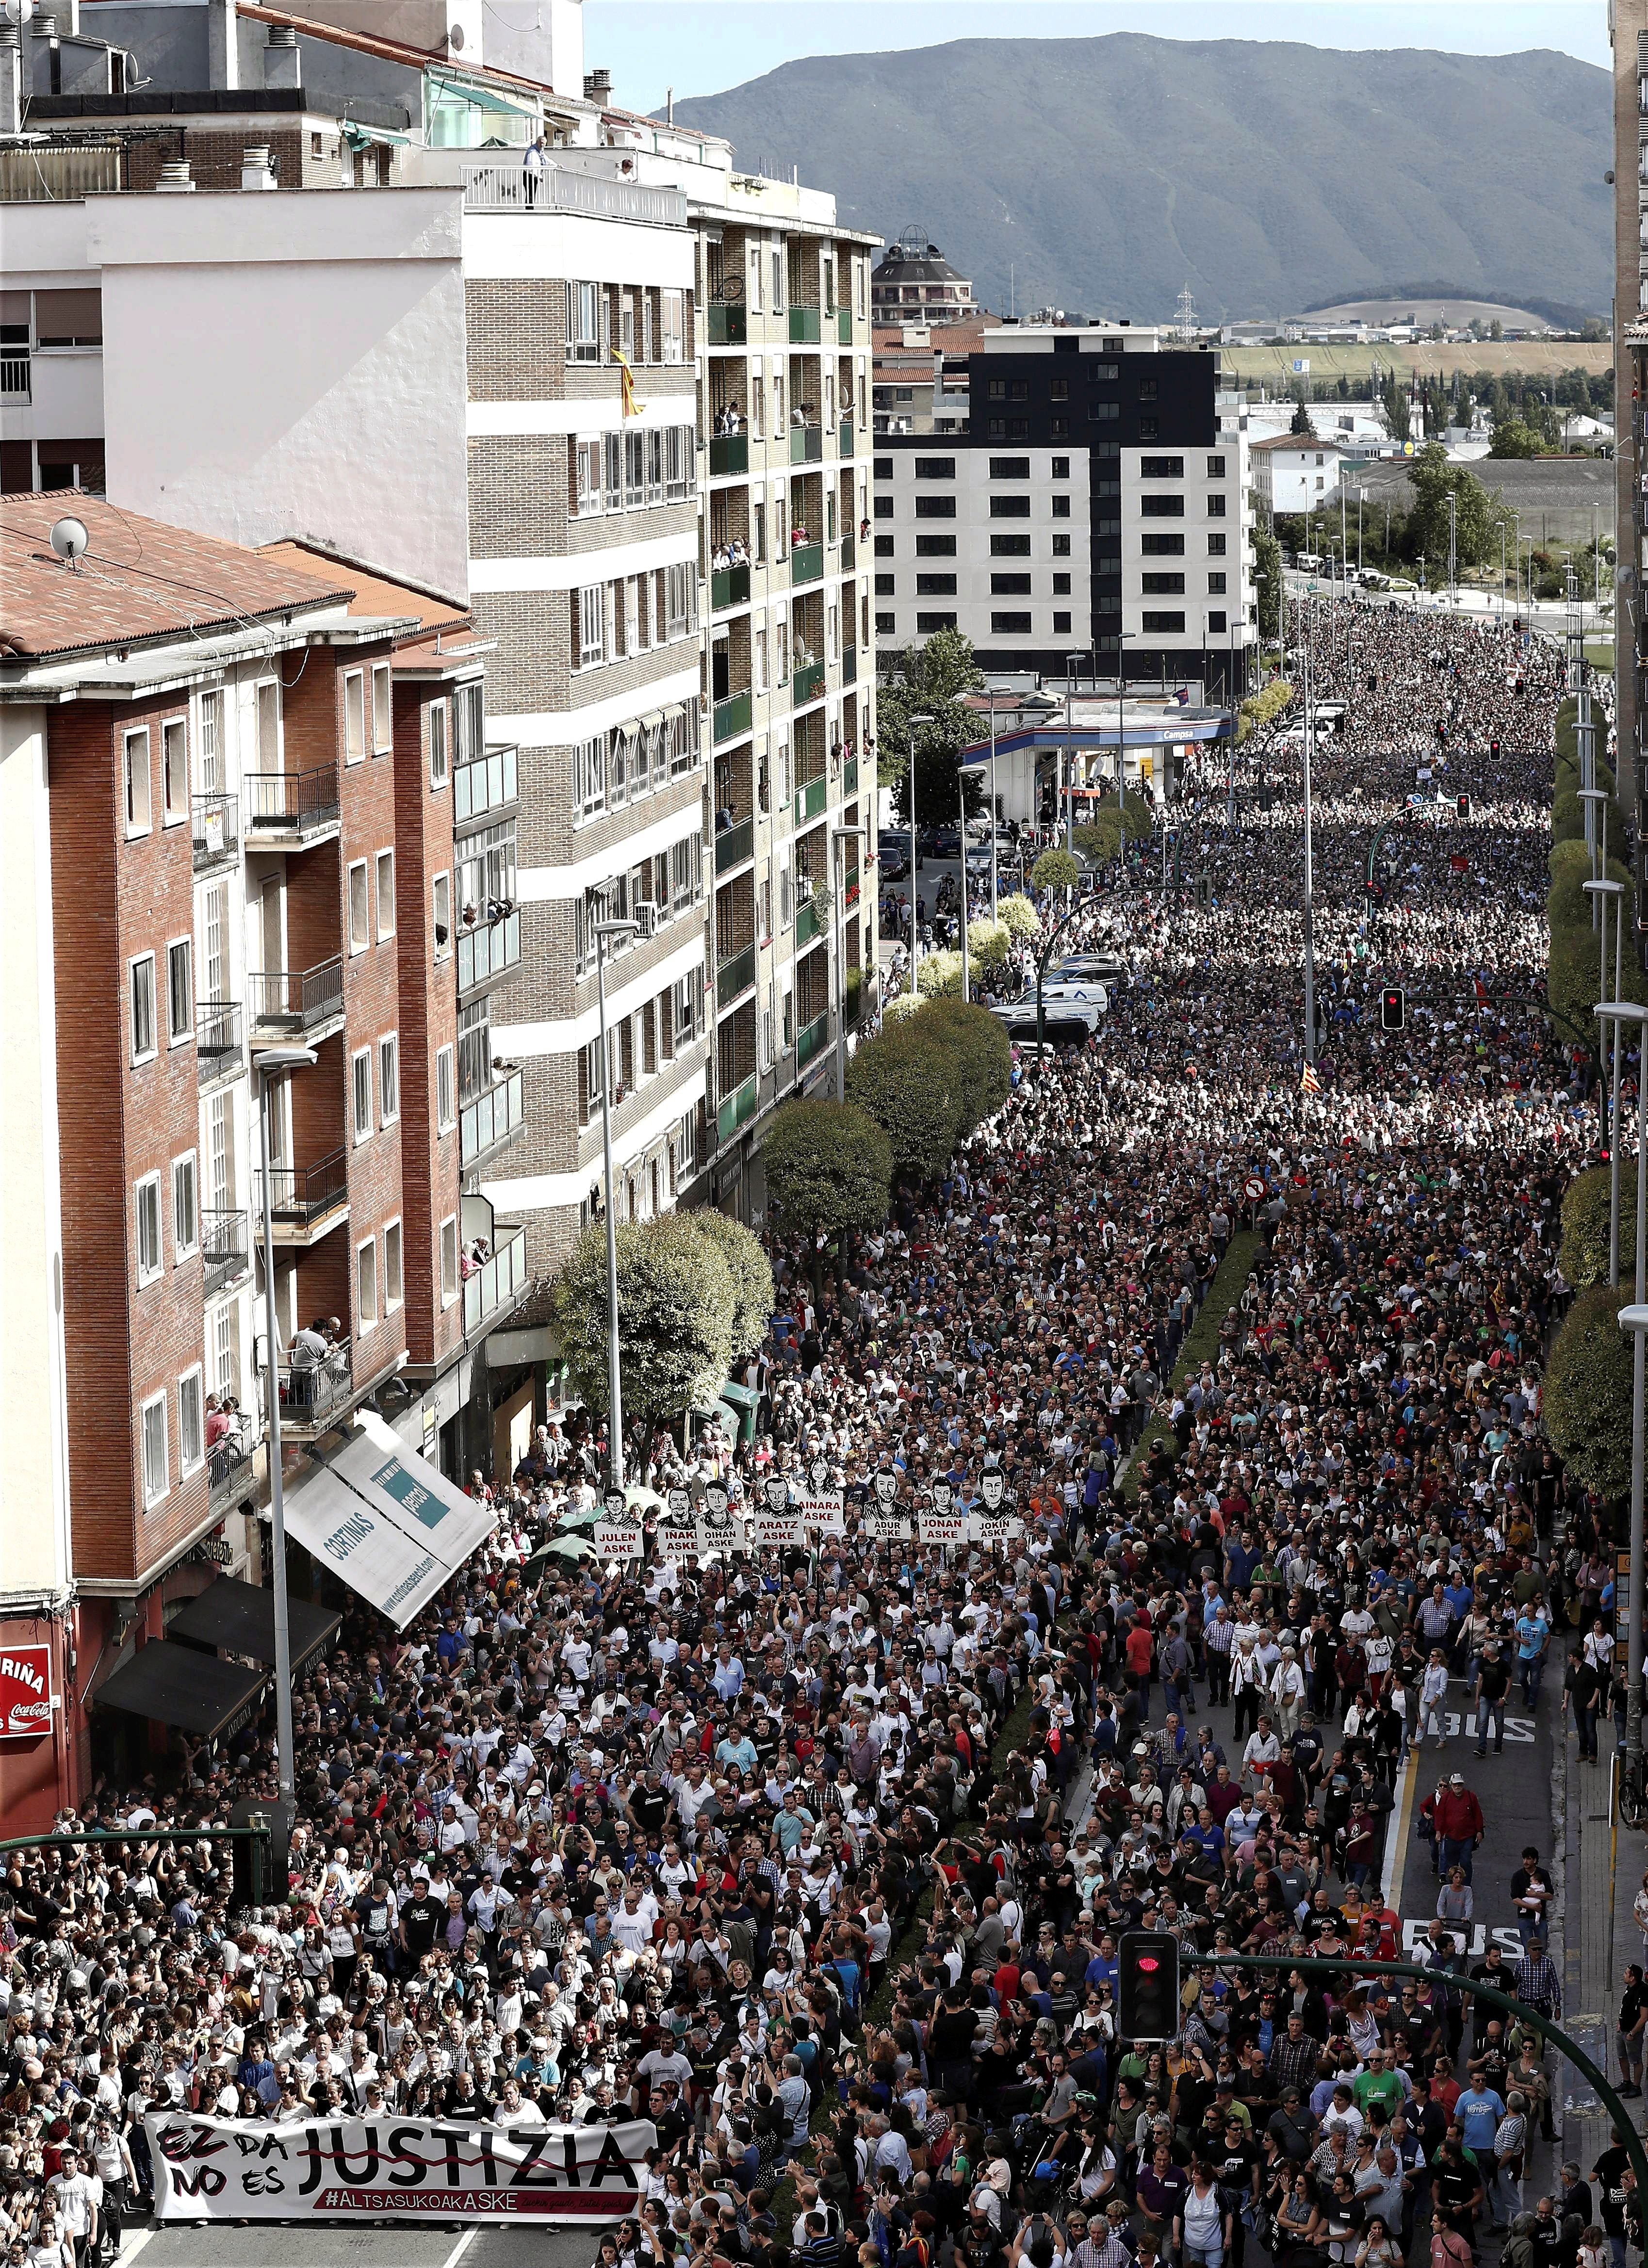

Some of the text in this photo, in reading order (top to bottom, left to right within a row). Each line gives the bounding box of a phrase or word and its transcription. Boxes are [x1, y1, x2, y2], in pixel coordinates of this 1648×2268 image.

[1163, 730, 1193, 740] Campsa
[401, 1482, 429, 1517] percol
[799, 1501, 840, 1510] AINARA
[804, 1512, 833, 1521] ASKE
[922, 1519, 962, 1528] JONAN
[979, 1520, 1010, 1530] JOKIN
[323, 1511, 375, 1560] CORTINAS
[600, 1532, 636, 1542] JULEN
[704, 1530, 736, 1539] OIHAN
[763, 1532, 794, 1540] ASKE
[875, 1528, 900, 1537] ASKE
[927, 1530, 958, 1539] ASKE
[980, 1528, 1007, 1537] ASKE
[667, 1542, 698, 1550] ASKE
[708, 1539, 734, 1547] ASKE
[604, 1544, 634, 1553] ASKE
[380, 1556, 439, 1615] www.cortinaspercol.com
[0, 1656, 44, 1695] RIÑA
[11, 1701, 50, 1717] Coca-Cola
[156, 2124, 289, 2162] EZ DA
[299, 2126, 637, 2195] JUSTIZIA
[170, 2165, 285, 2197] NO ES
